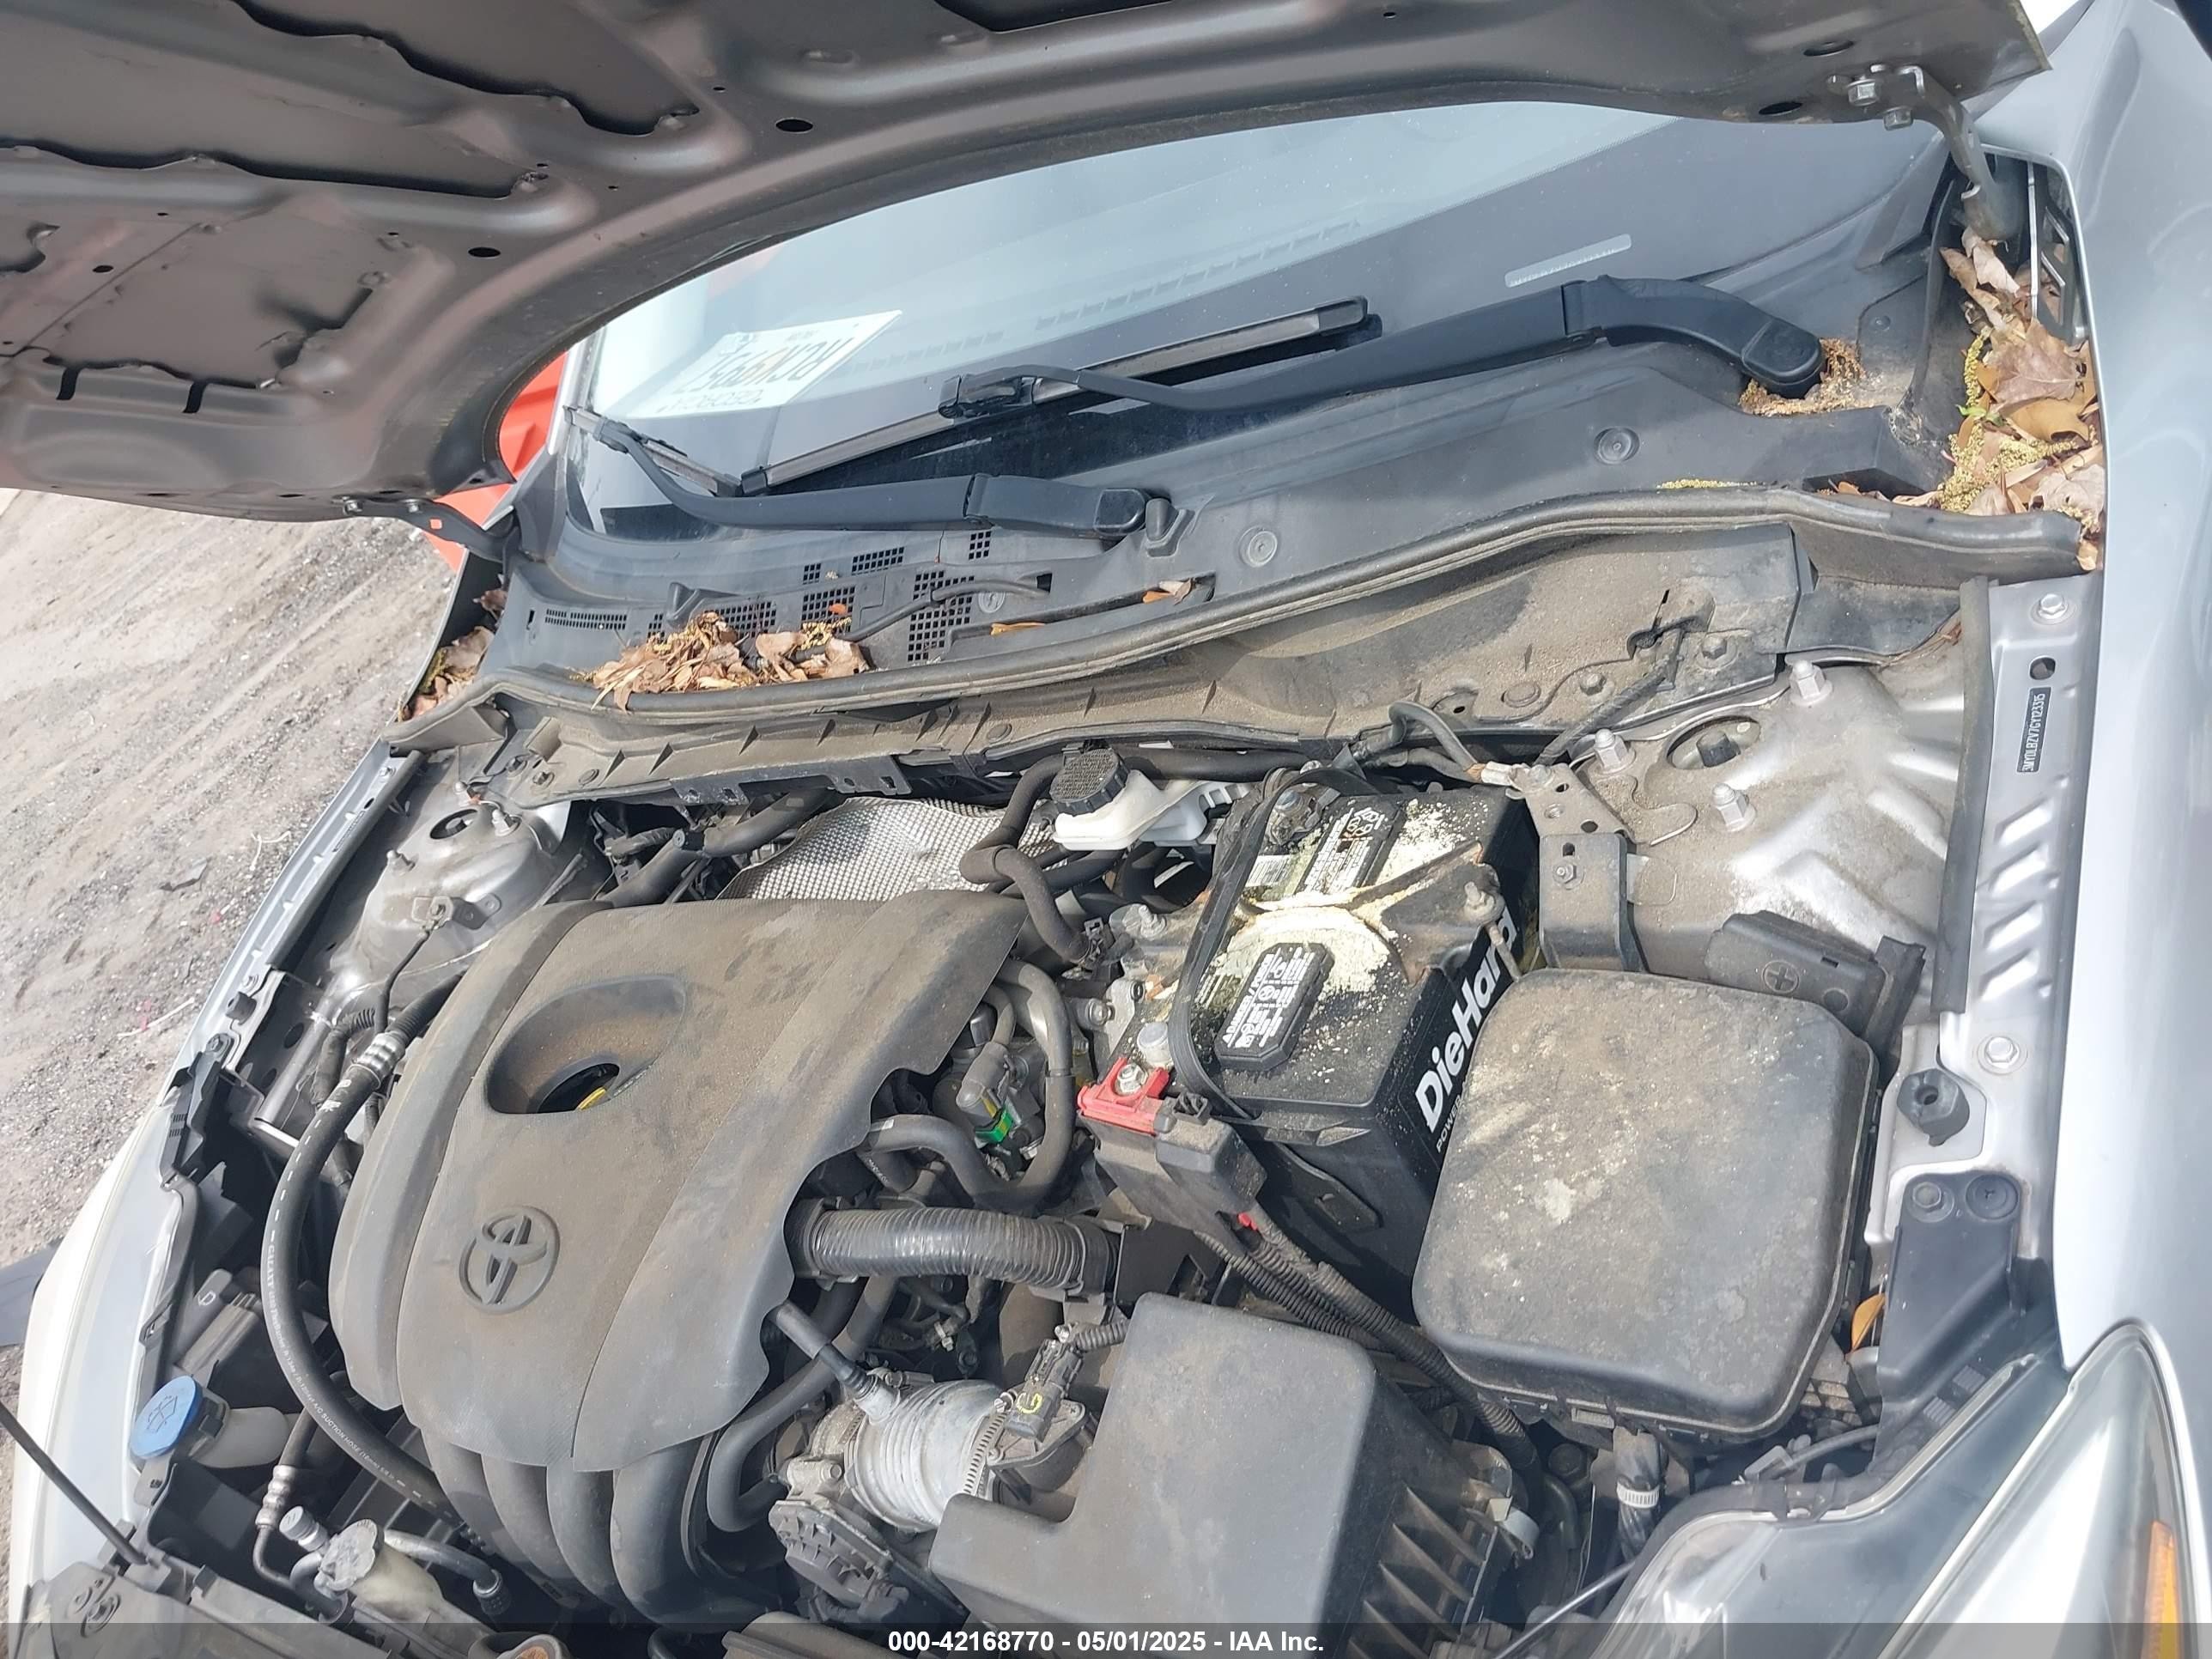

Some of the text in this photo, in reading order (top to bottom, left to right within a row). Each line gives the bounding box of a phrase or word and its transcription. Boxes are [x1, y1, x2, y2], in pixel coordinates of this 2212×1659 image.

[1415, 905, 1517, 1133] DieHard
[1435, 1094, 1462, 1153] POWER
[321, 1413, 346, 1439] SUCTION
[343, 1437, 362, 1452] HOSE
